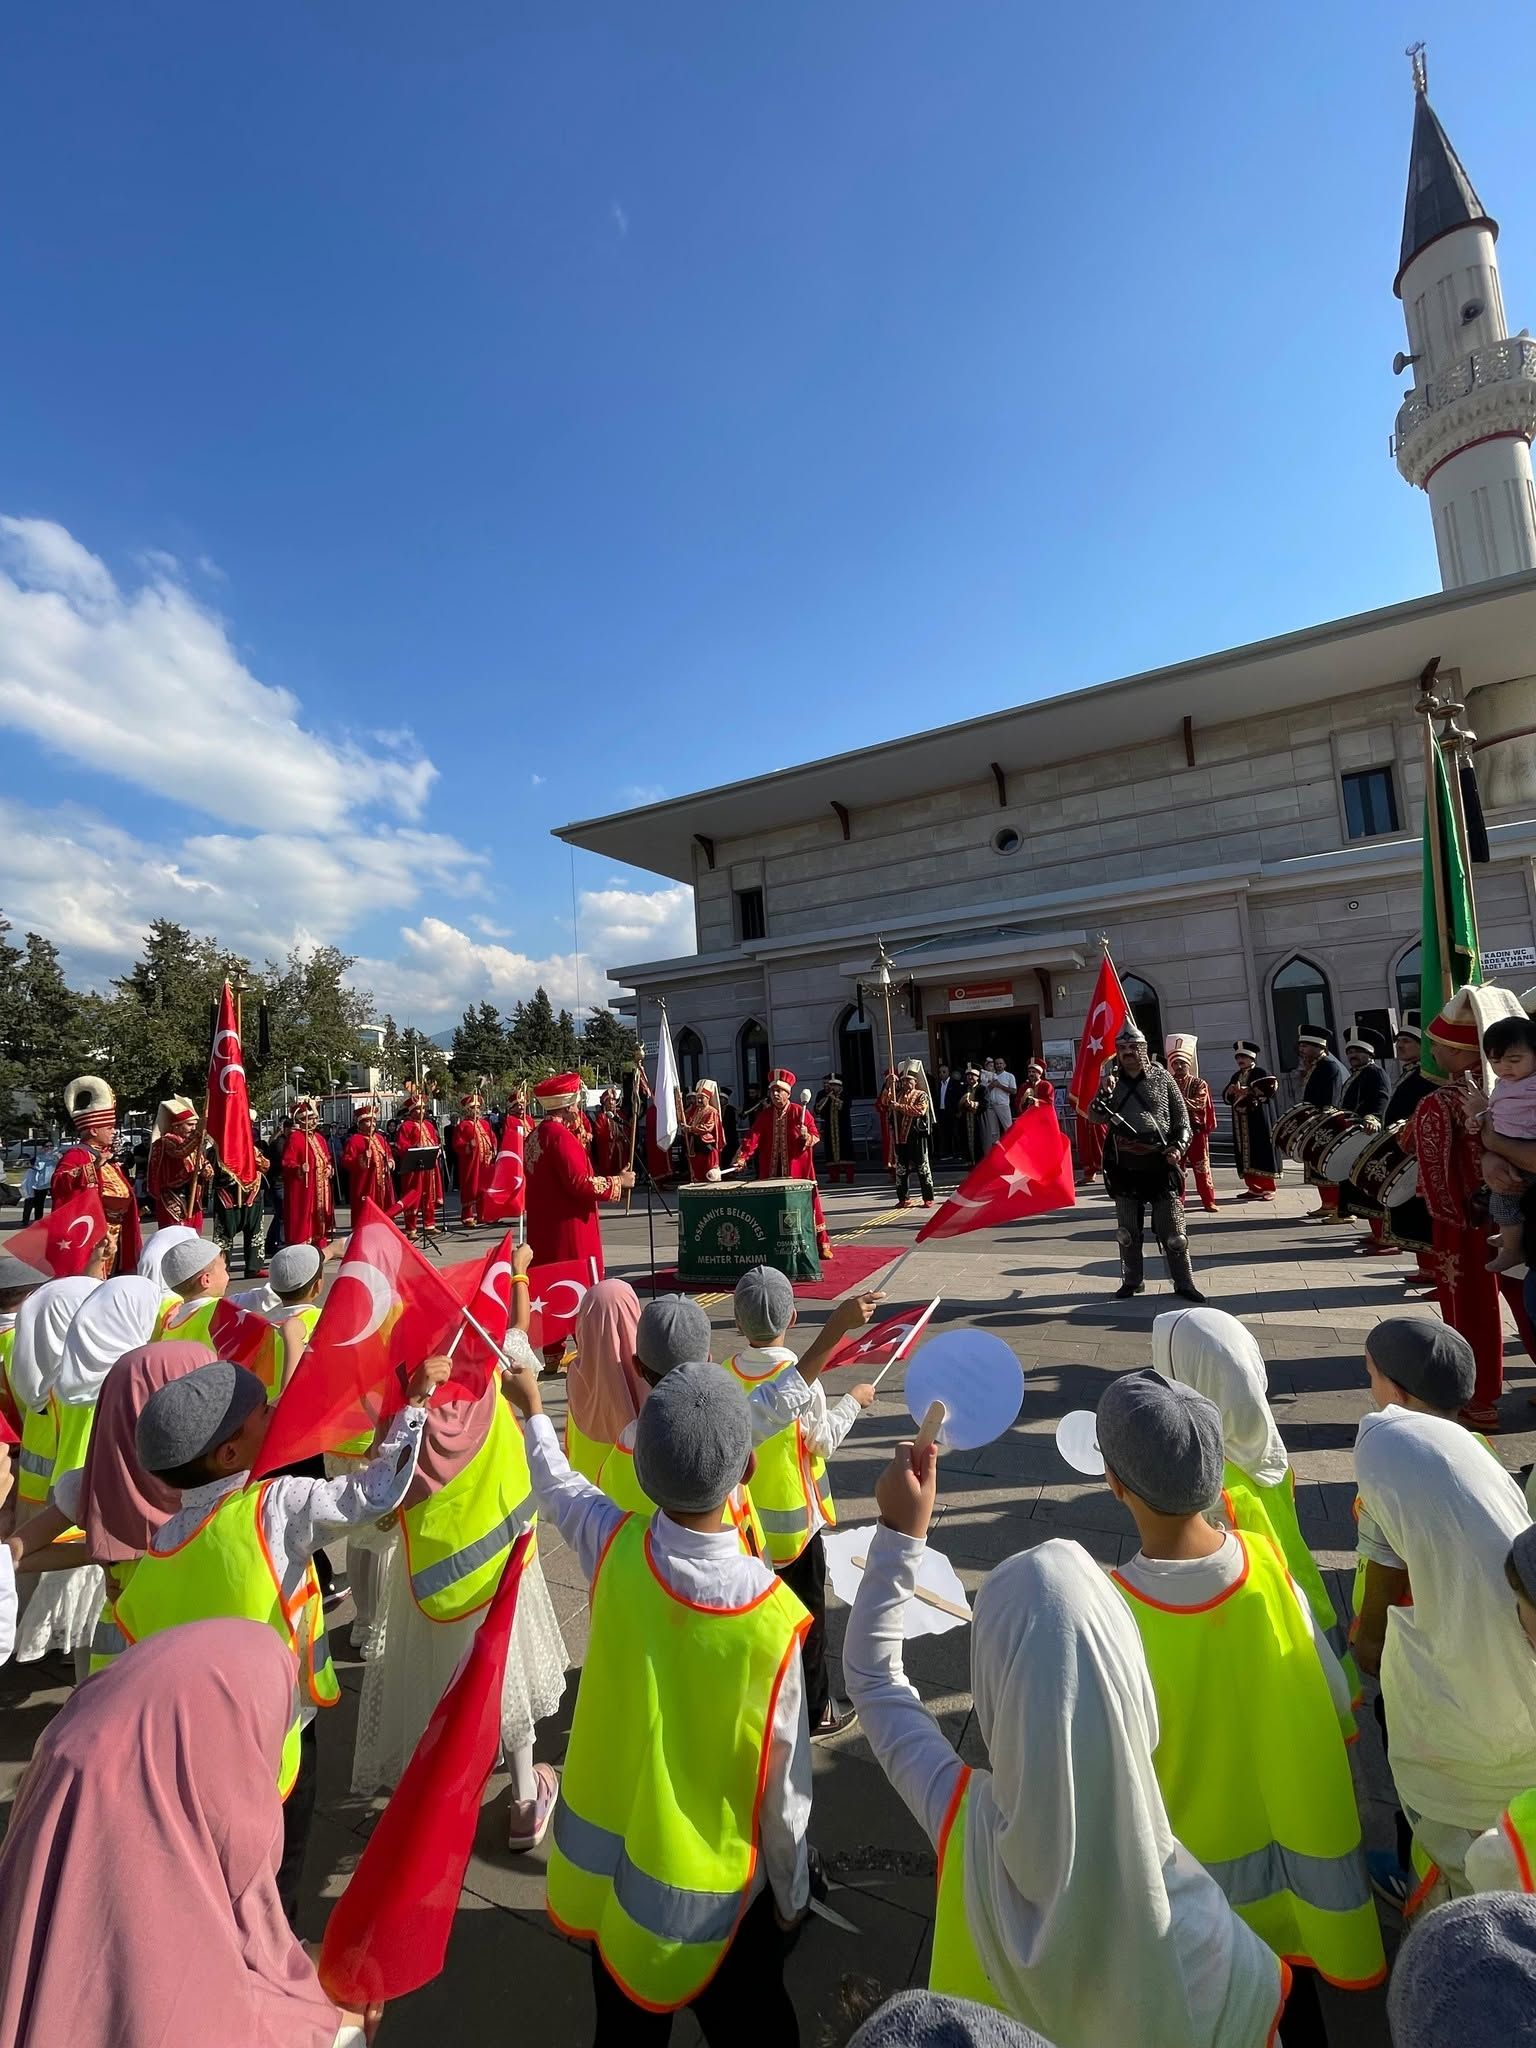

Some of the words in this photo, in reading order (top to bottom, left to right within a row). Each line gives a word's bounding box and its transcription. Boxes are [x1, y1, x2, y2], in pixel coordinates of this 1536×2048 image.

[695, 1207, 725, 1241] OSMANİYE
[697, 1255, 732, 1264] MEHTER
[734, 1254, 767, 1264] TAKIMI
